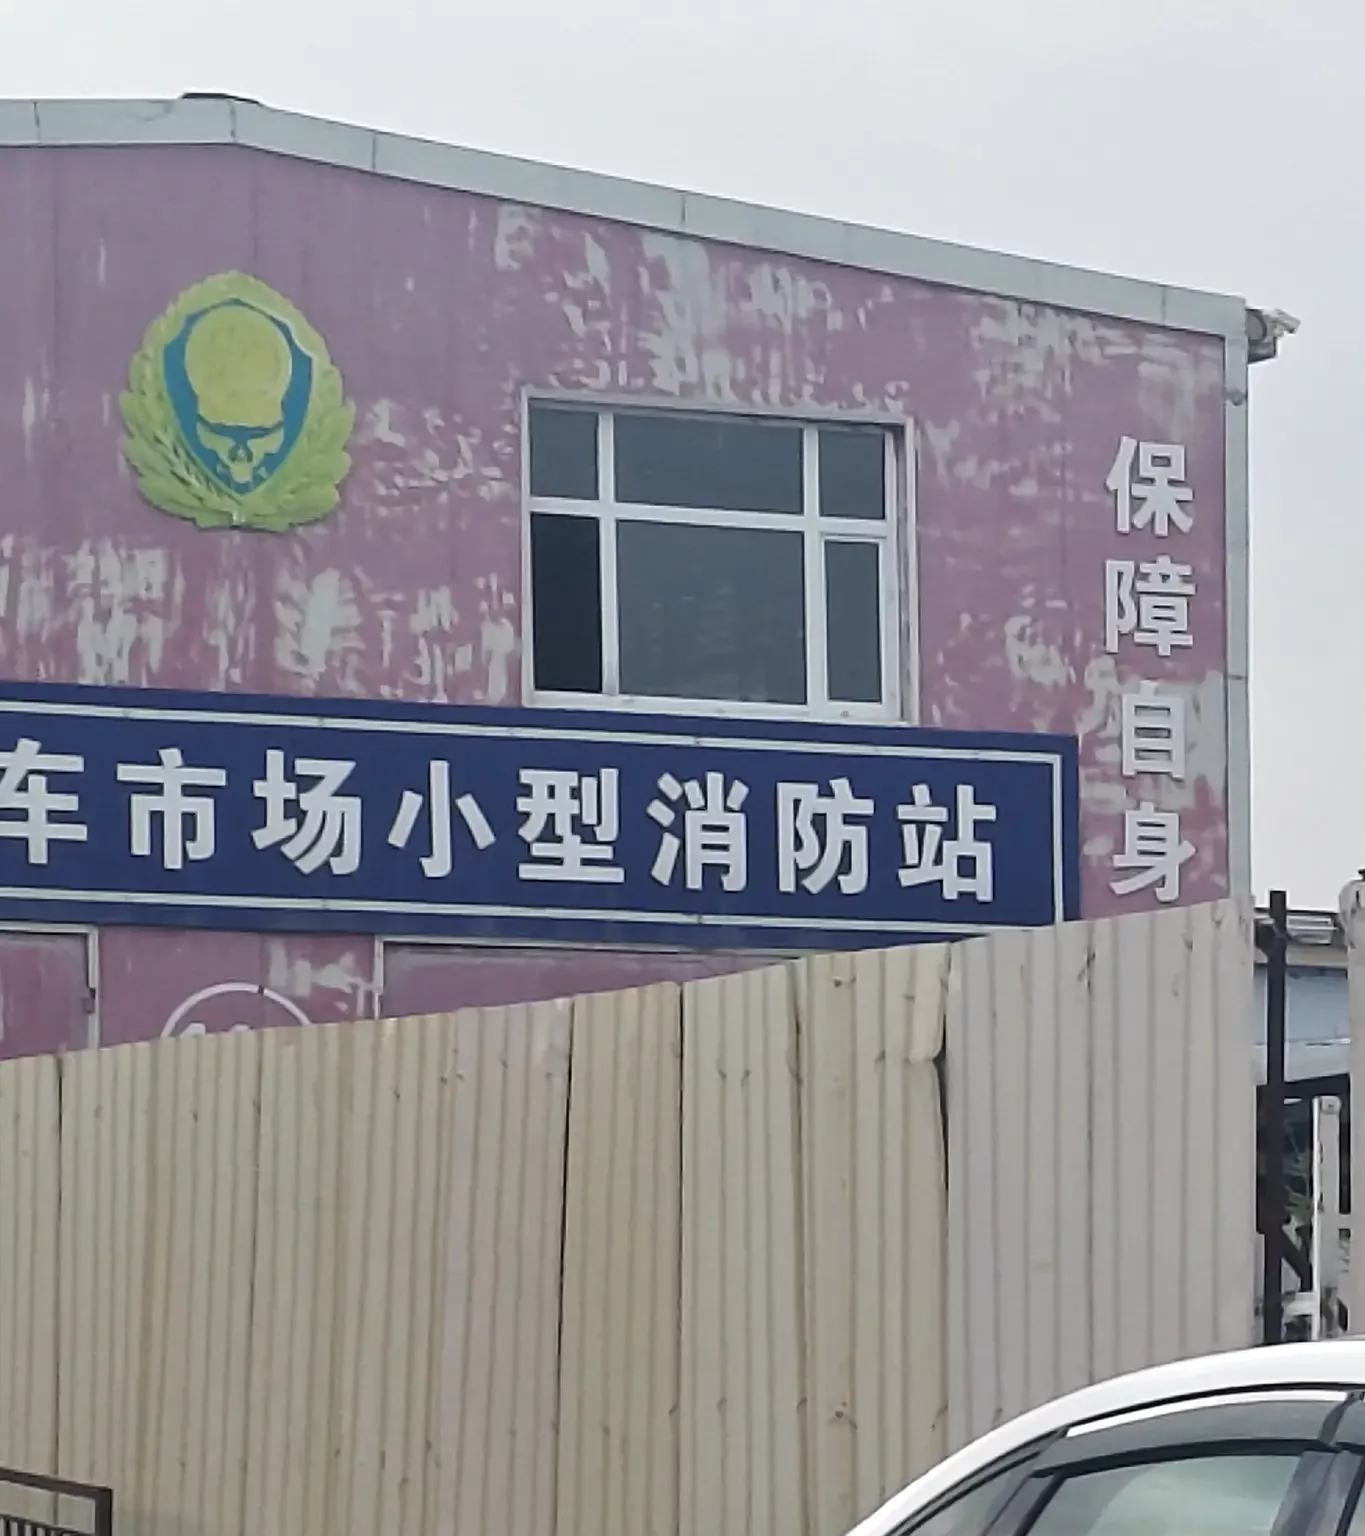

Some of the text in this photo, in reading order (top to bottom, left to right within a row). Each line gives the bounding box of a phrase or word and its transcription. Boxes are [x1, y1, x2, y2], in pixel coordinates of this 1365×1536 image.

[0, 737, 998, 903] 车市场小型消防站
[1104, 434, 1197, 903] 保障自身
